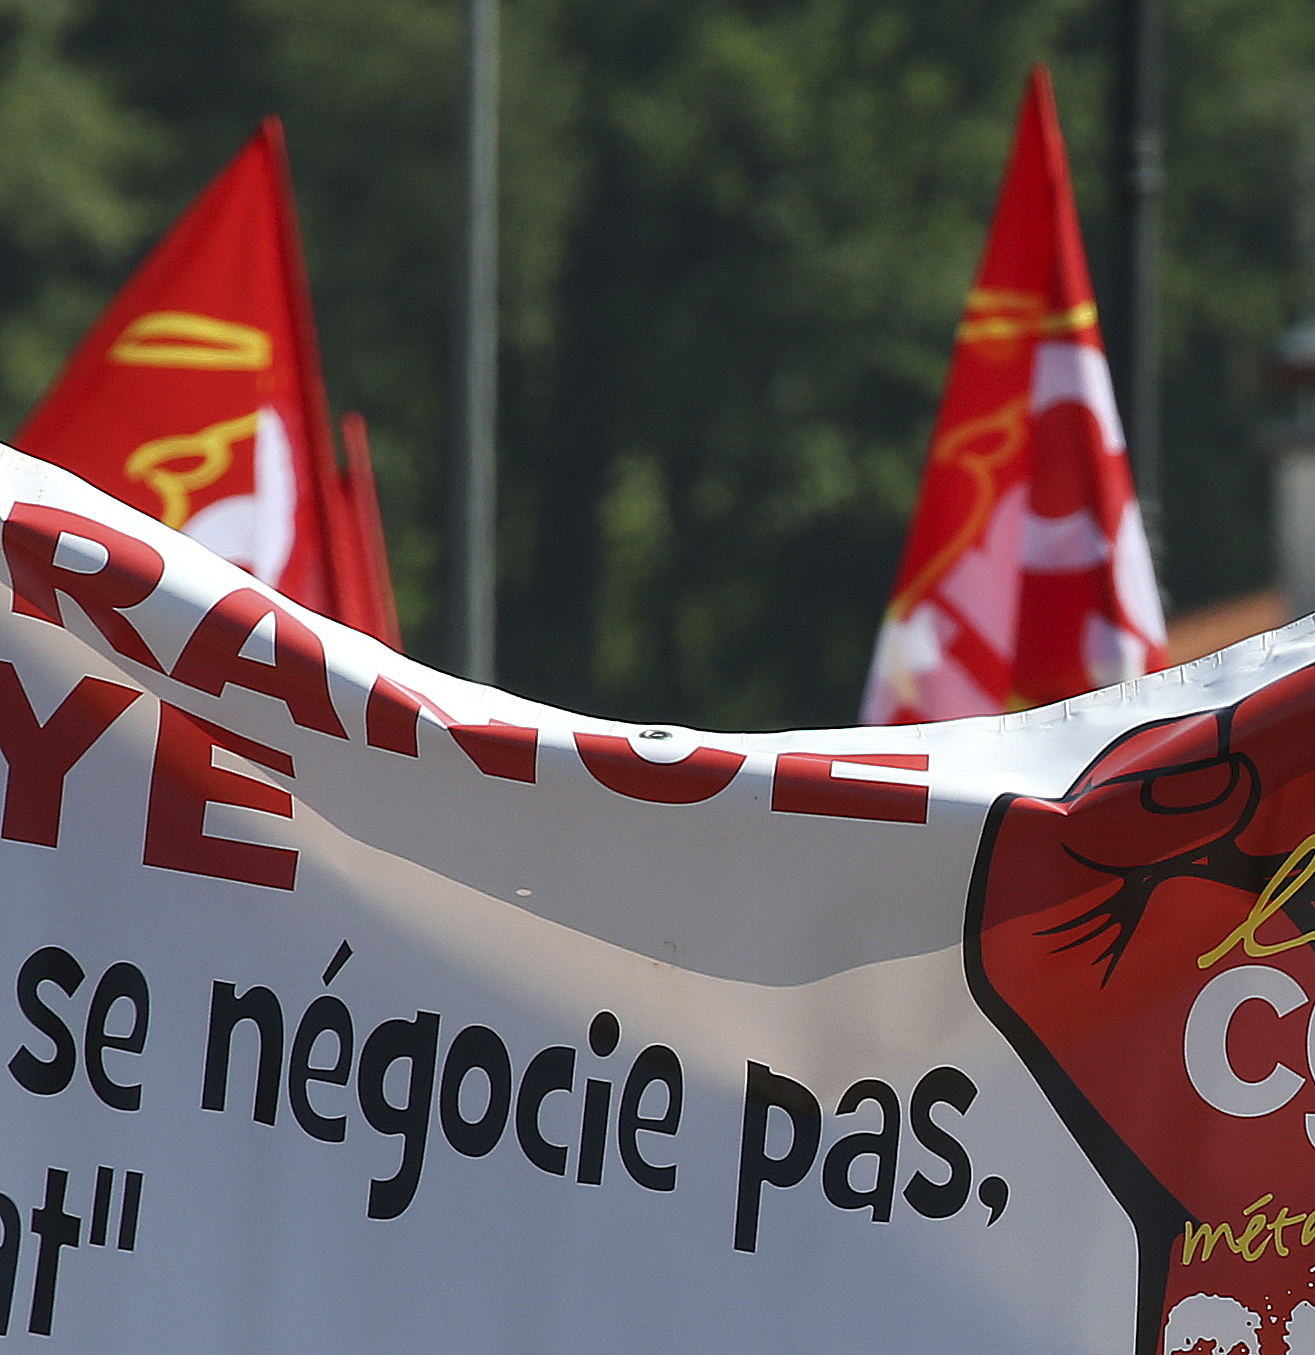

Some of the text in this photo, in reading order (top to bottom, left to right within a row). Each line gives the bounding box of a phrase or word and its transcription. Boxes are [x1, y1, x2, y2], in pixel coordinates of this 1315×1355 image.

[6, 938, 1010, 1254] se négocie pas,
[0, 1164, 144, 1337] t"
